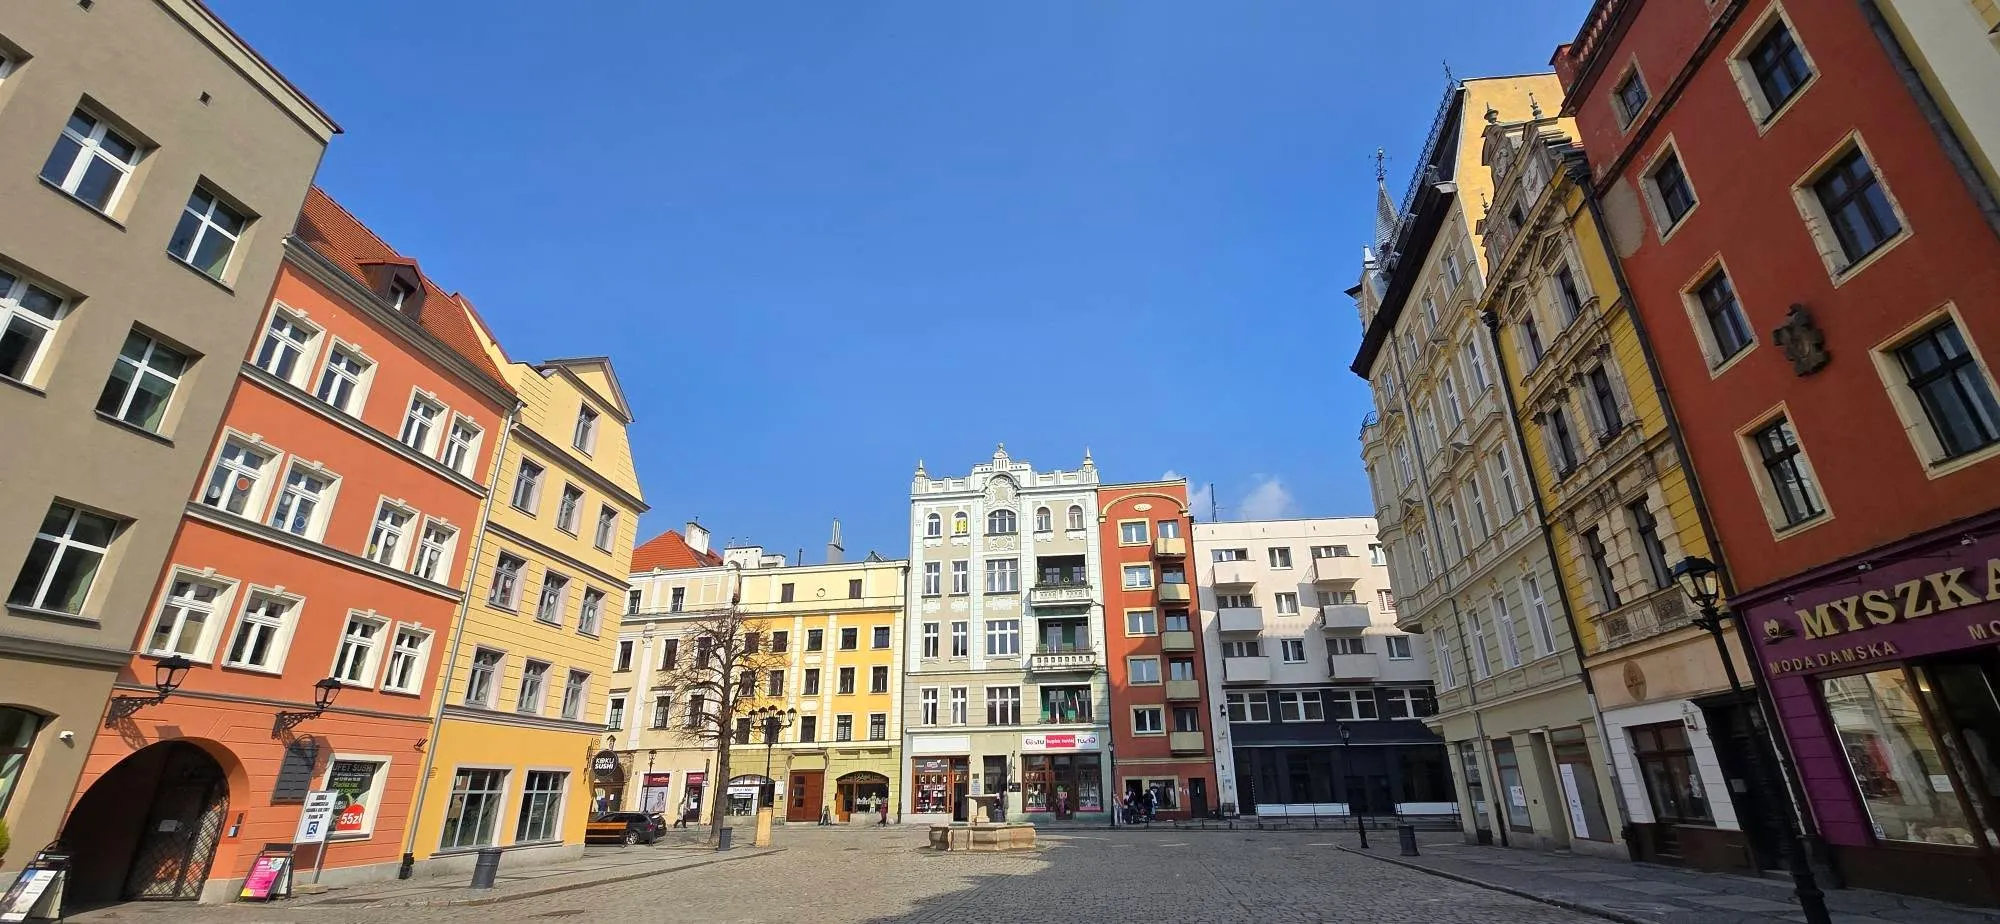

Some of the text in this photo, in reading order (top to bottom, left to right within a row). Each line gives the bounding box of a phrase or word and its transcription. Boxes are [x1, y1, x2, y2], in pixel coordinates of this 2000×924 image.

[1768, 641, 1897, 674] MODA DAMSKA
[352, 763, 374, 772] SUSHI
